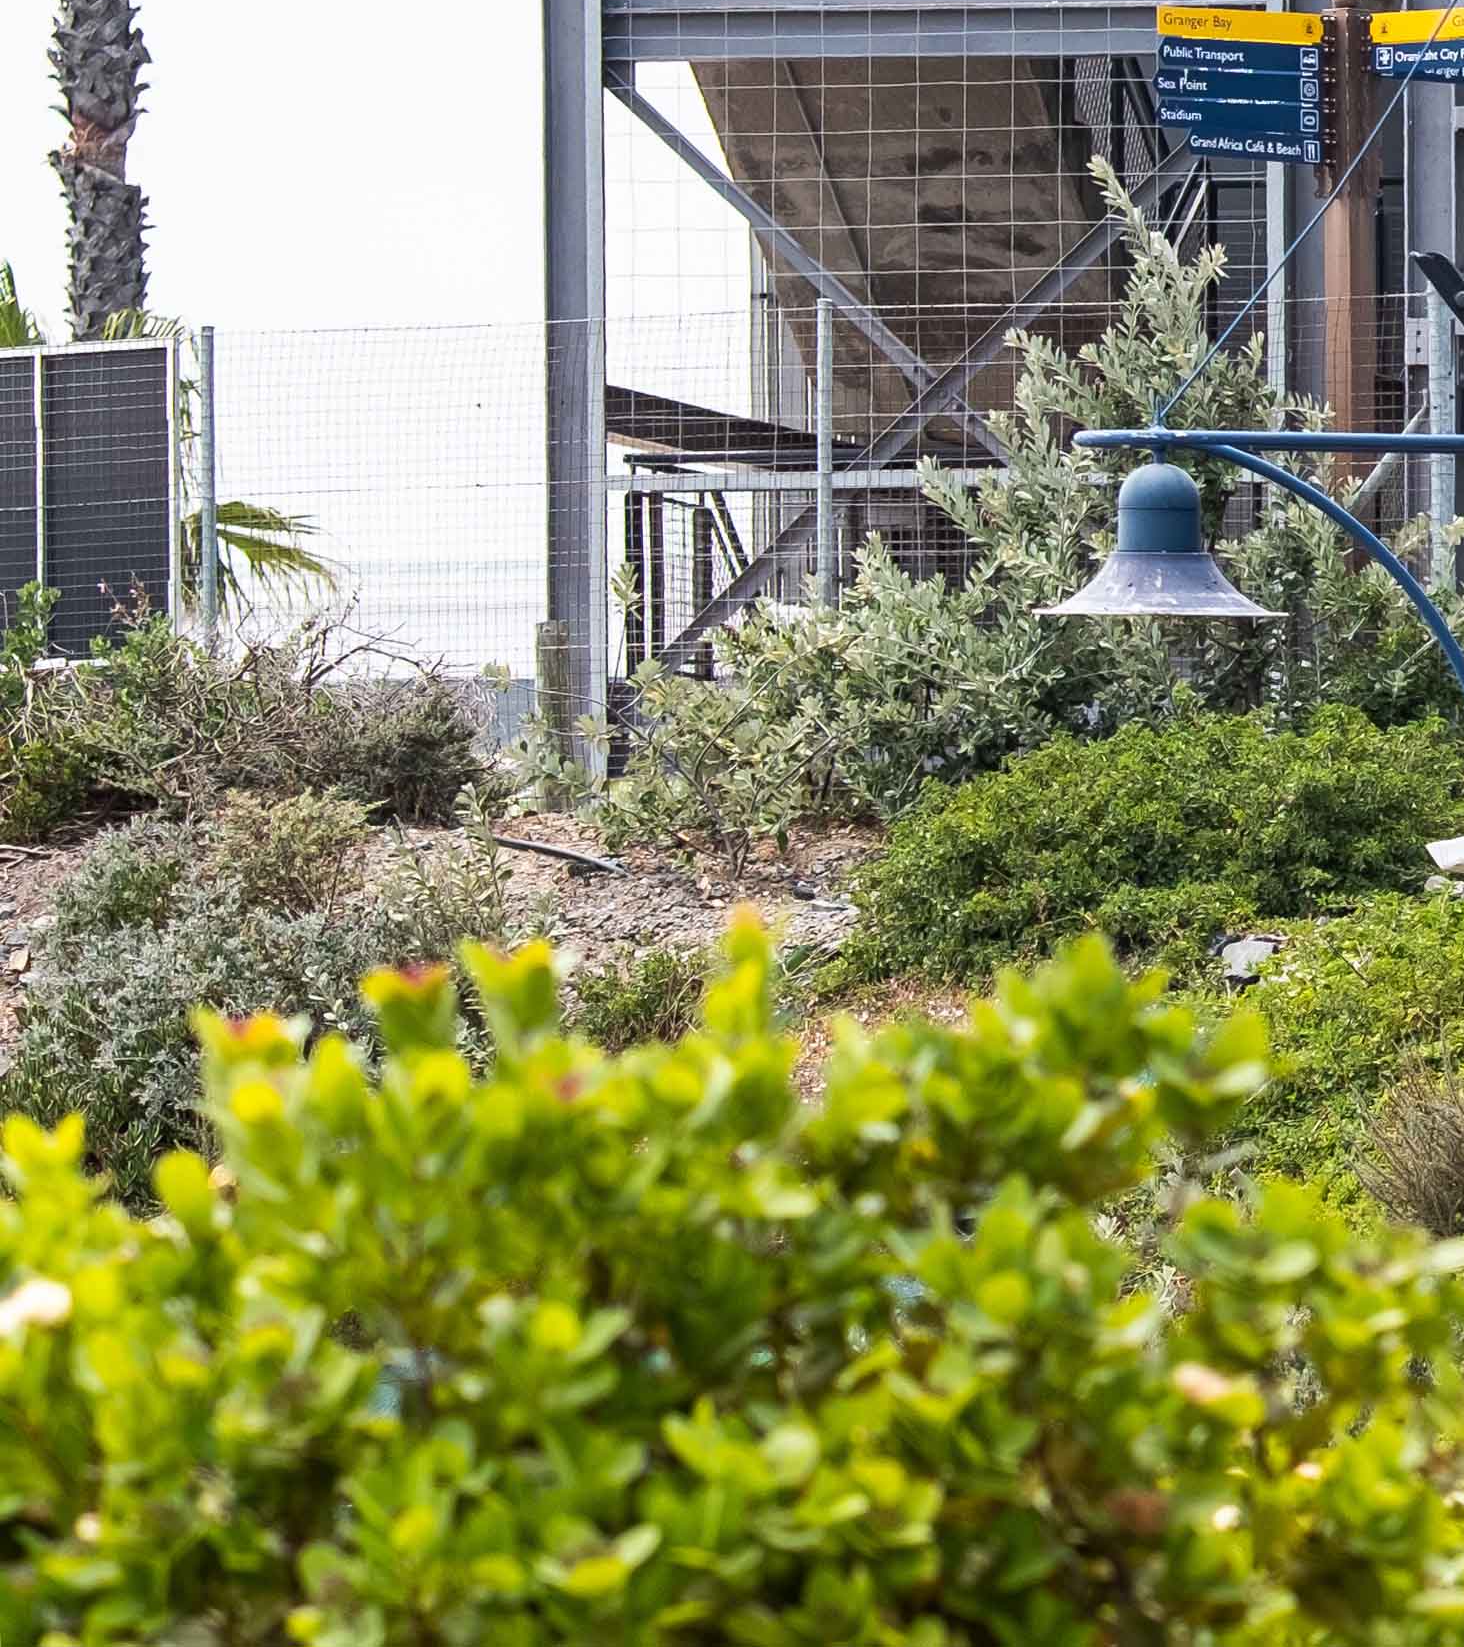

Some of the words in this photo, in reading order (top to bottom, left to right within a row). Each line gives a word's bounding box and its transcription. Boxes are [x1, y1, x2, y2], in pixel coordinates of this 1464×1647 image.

[1163, 13, 1208, 30] Granger
[1213, 15, 1232, 31] Bay
[1163, 45, 1193, 59] Public
[1195, 47, 1245, 63] Transport
[1440, 48, 1458, 62] City
[1158, 77, 1176, 89] Sea
[1179, 77, 1207, 92] Point
[1160, 107, 1202, 121] Stadium
[1190, 135, 1217, 149] Grand
[1218, 136, 1243, 151] Africa
[1266, 141, 1275, 154] &
[1276, 142, 1302, 156] Beach
